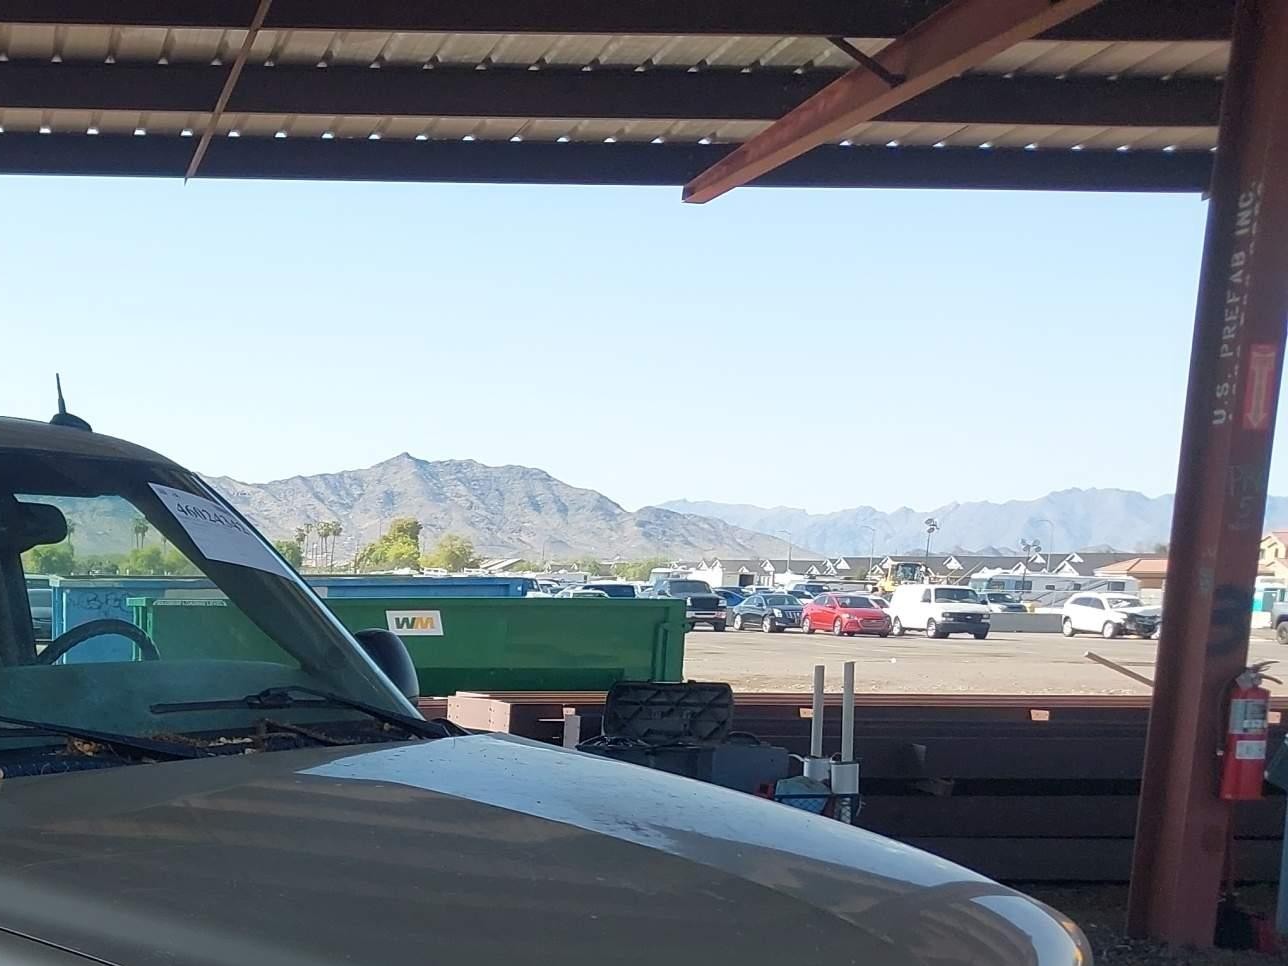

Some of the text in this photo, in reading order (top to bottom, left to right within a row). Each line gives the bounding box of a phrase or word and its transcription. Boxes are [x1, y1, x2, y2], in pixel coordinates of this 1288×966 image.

[1220, 251, 1246, 358] PREFAB
[1212, 373, 1231, 424] U.S.
[394, 616, 435, 630] WM
